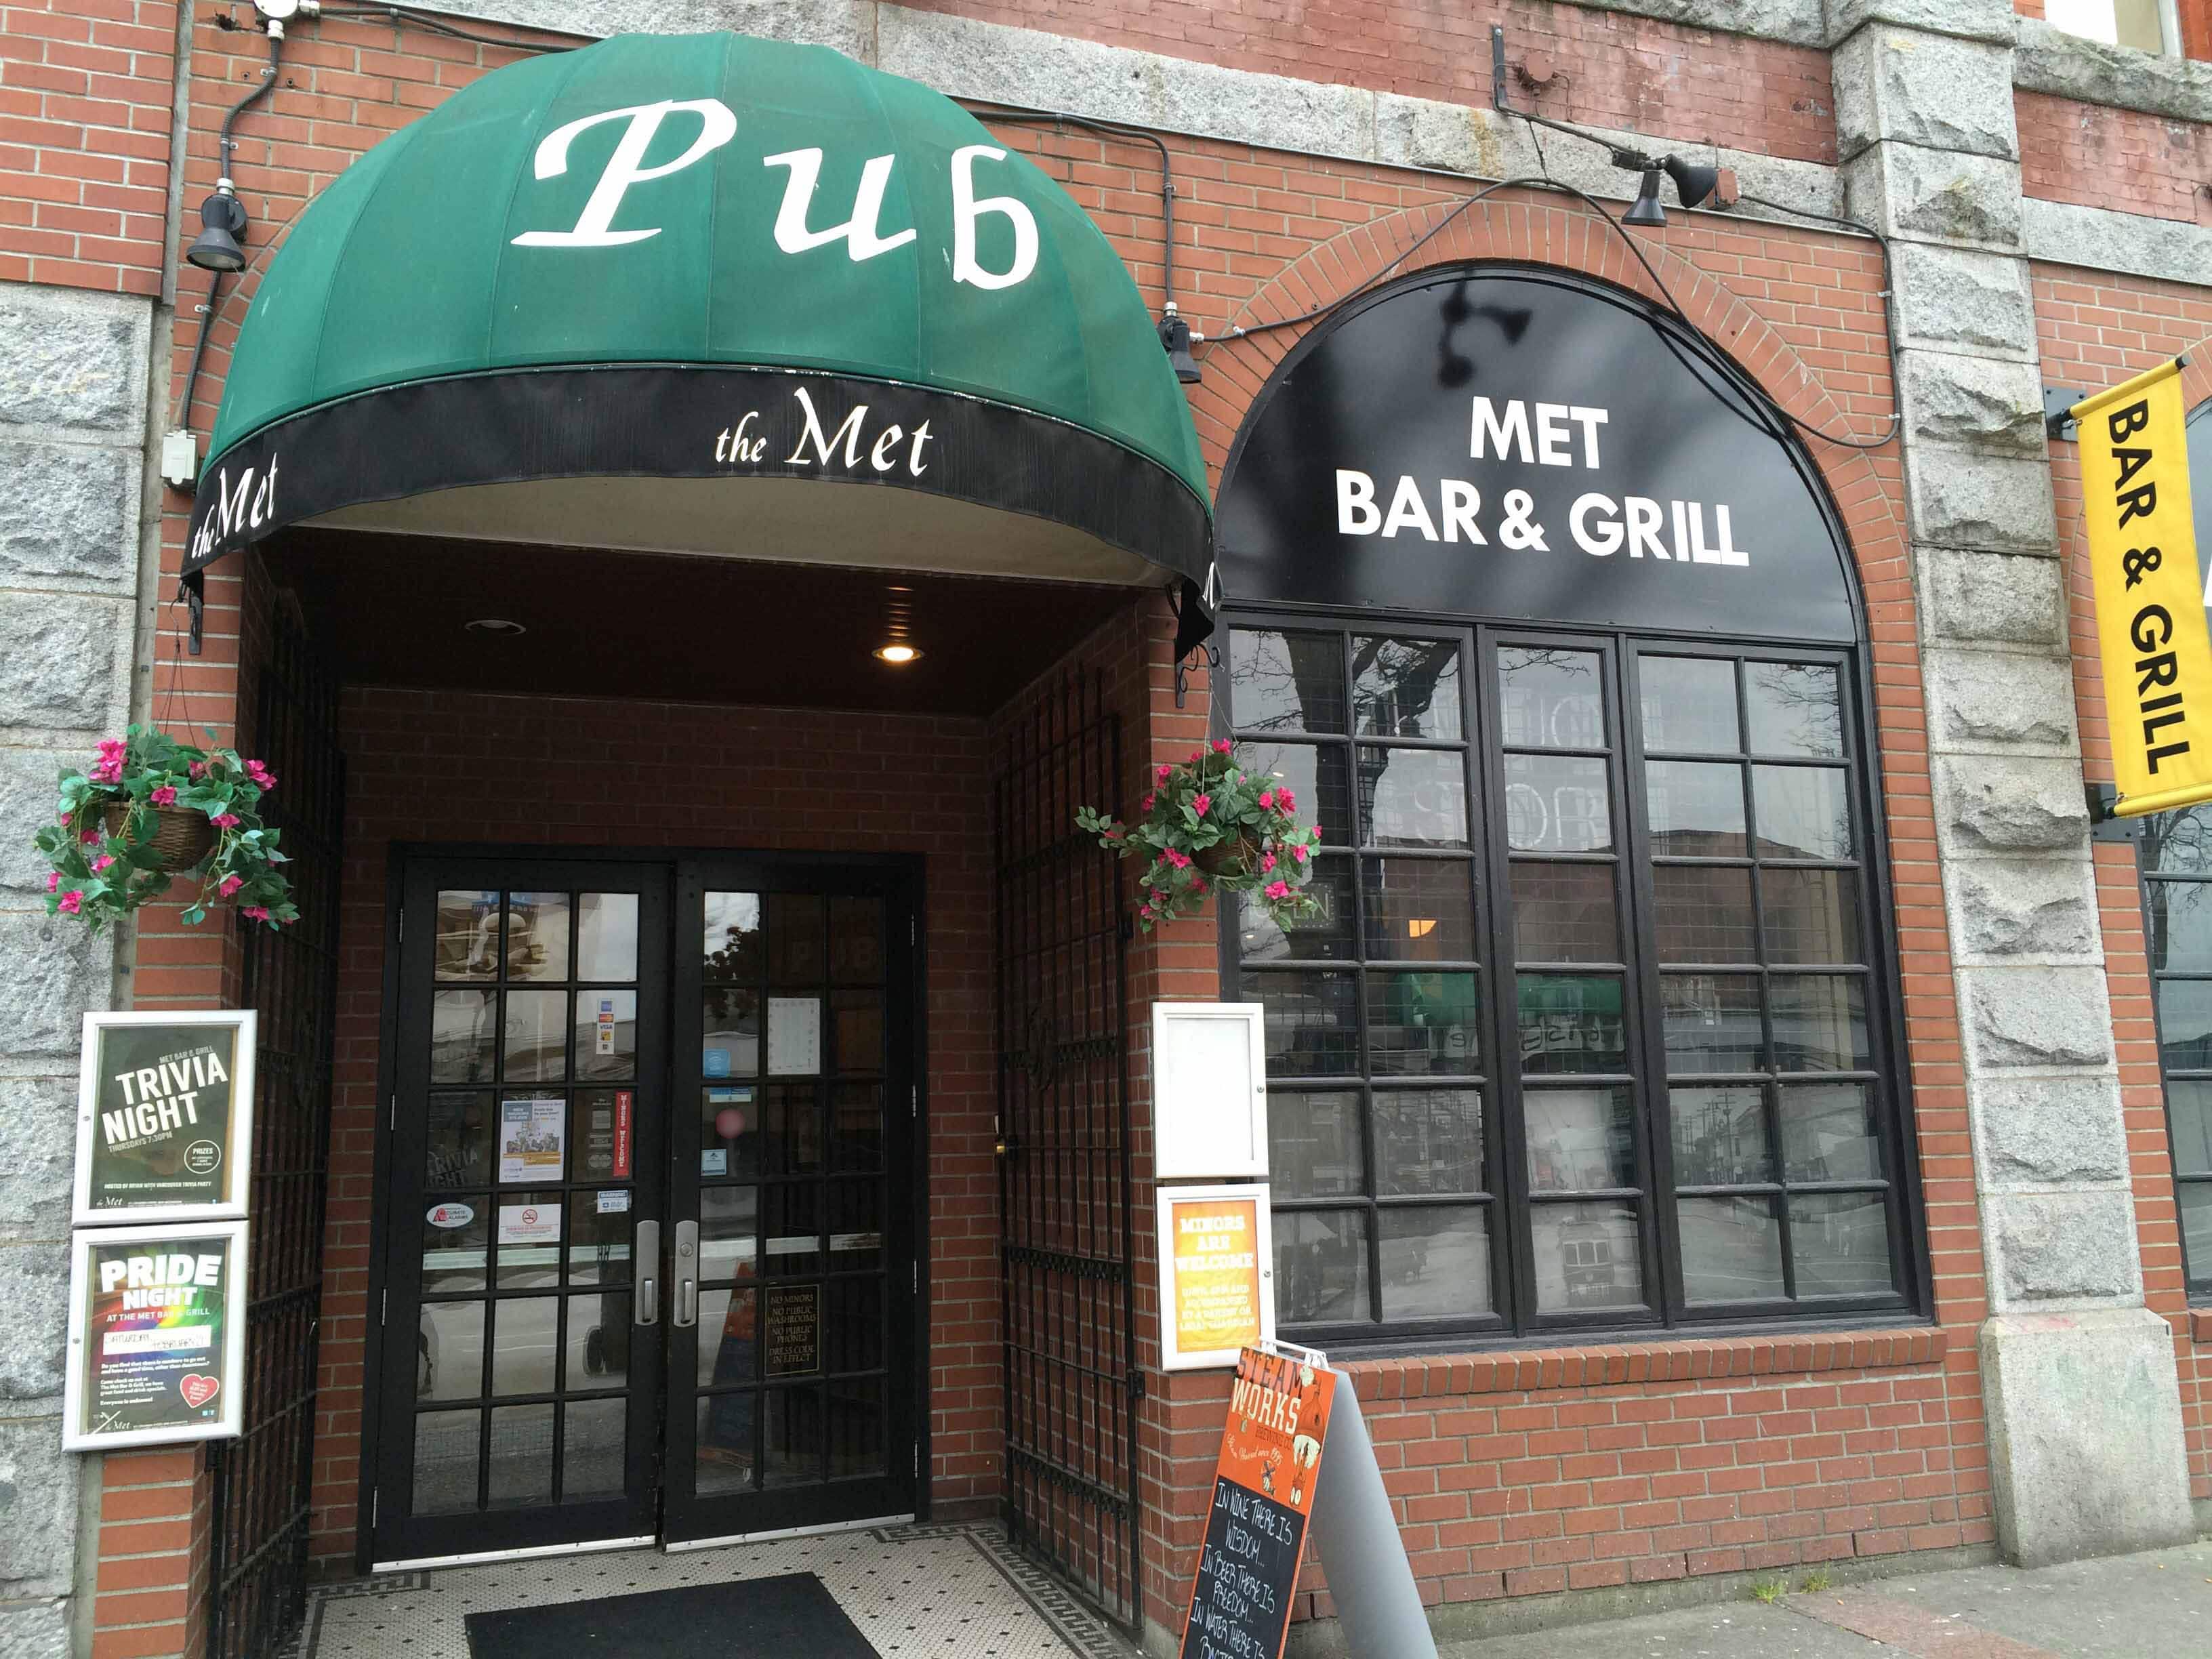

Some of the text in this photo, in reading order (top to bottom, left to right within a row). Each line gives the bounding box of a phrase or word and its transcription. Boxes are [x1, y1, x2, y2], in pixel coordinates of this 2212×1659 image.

[510, 97, 1040, 290] Pub
[714, 386, 934, 477] the Met
[1470, 396, 1609, 470] MET
[191, 452, 279, 558] the Met
[1336, 469, 1750, 567] BAR & GRILL
[2108, 398, 2190, 775] BAR & GRILL
[159, 1054, 173, 1064] MET
[174, 1051, 188, 1061] BAR
[195, 1046, 214, 1056] GRILL
[115, 1052, 228, 1105] TRIVIA
[102, 1091, 199, 1145] NIGHT
[108, 1136, 147, 1153] THURSDAYS
[1179, 1214, 1246, 1233] MINORS
[1175, 1253, 1254, 1271] WELCOME
[1196, 1235, 1231, 1252] ARE
[100, 1254, 222, 1293] PRIDE
[119, 1313, 136, 1321] THE
[137, 1311, 156, 1319] MET
[157, 1311, 174, 1319] BAR
[186, 1308, 210, 1316] GRILL
[123, 1286, 199, 1311] NIGHT
[771, 1294, 814, 1304] NO MINORS
[773, 1306, 813, 1315] NO PUBLIC
[766, 1314, 816, 1324] WASHROOMS
[773, 1325, 813, 1335] NO PUBLIC
[769, 1345, 814, 1356] DRESS CODE
[777, 1334, 808, 1344] PHONES
[1236, 1348, 1303, 1399] STEAM
[1231, 1377, 1301, 1435] WORKS
[1215, 1482, 1292, 1546] IN WINE THERE IS
[1200, 1543, 1275, 1614] IN BEER THERE IS
[1191, 1597, 1204, 1625] IN
[1206, 1603, 1228, 1645] WATER
[1229, 1620, 1252, 1658] THERE
